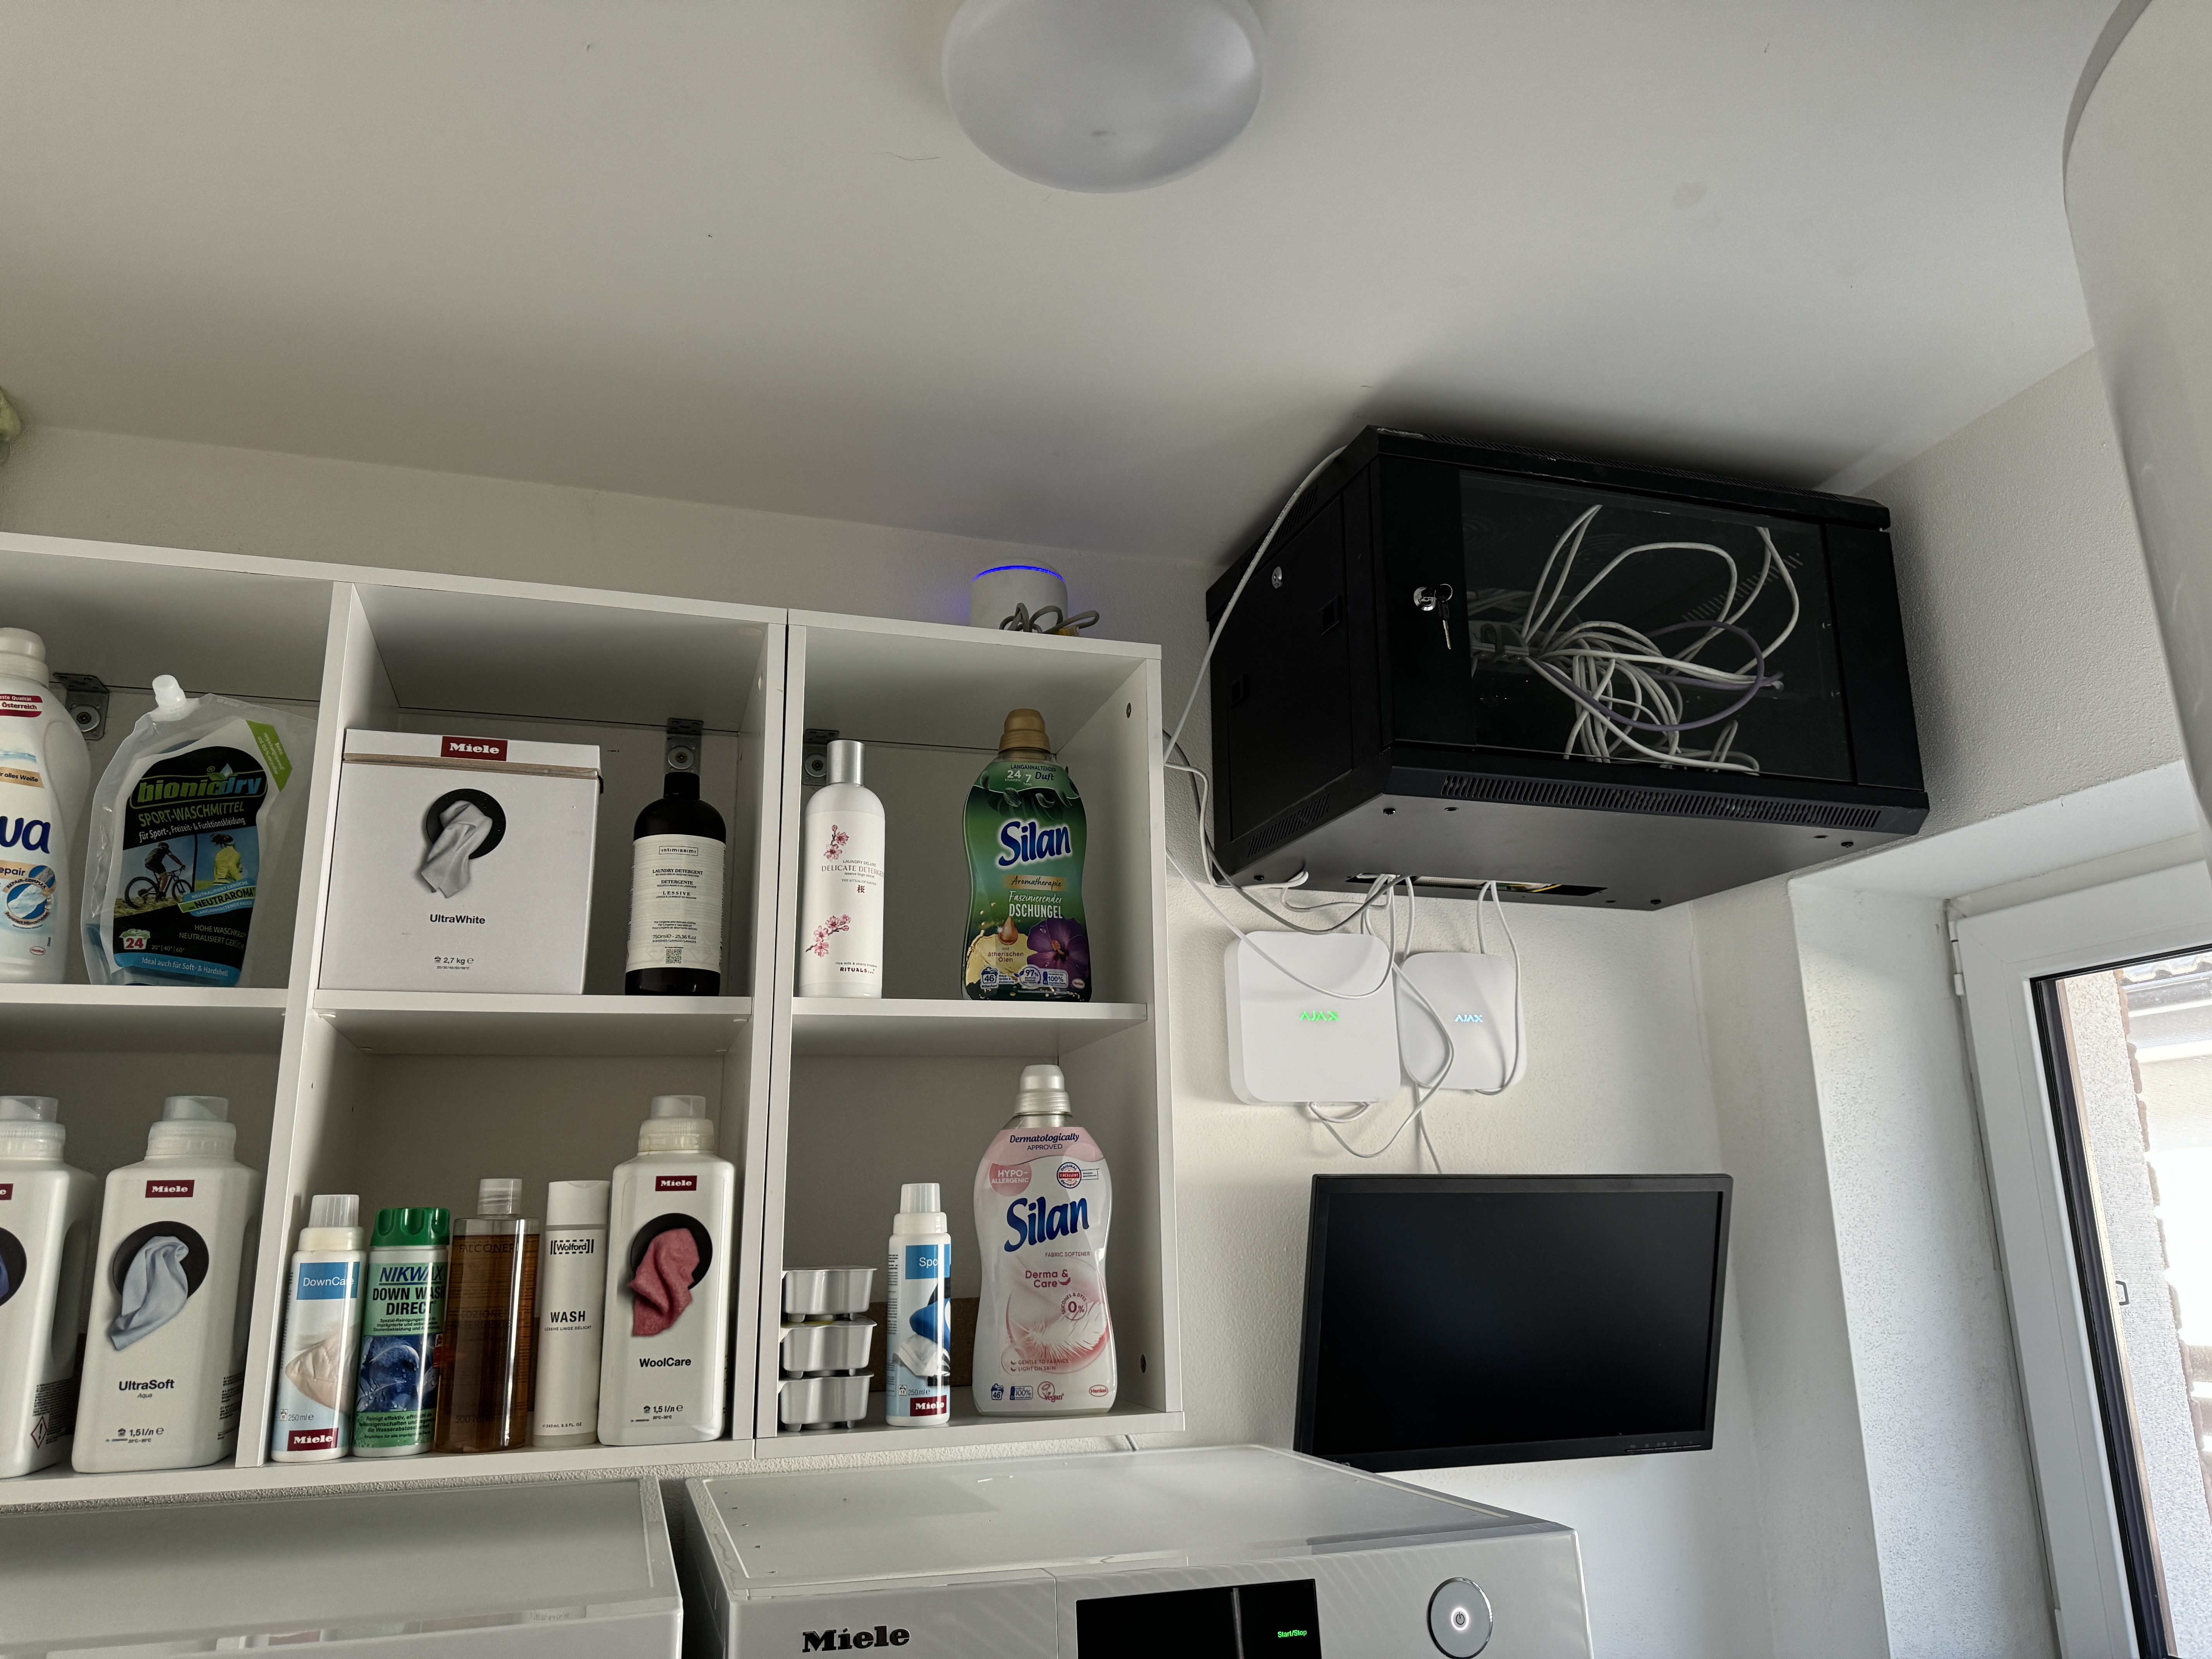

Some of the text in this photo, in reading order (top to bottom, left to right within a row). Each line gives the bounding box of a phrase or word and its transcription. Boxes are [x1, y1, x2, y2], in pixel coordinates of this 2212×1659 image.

[450, 743, 500, 754] Miele
[1035, 772, 1054, 781] Duft
[137, 777, 262, 802] bionicdry
[138, 801, 244, 827] SPORT-WASCHMITTEL
[139, 830, 149, 843] für
[171, 824, 192, 834] Freizeit-
[198, 817, 246, 830] Funktionskleidung
[998, 821, 1071, 866] Silan
[857, 884, 865, 893] 桜
[1011, 876, 1061, 890] Aromatherapie
[194, 887, 253, 908] NEUTRAROMA
[1009, 891, 1063, 904] Faszinierender
[1009, 903, 1063, 919] DSCHUNGEL
[430, 914, 486, 924] UltraWhite
[125, 938, 144, 948] 24
[179, 933, 225, 944] NEUTRALISIERT
[203, 967, 228, 977] Hardshell
[1300, 1011, 1340, 1021] AJAX
[1455, 1014, 1484, 1023] AJAX
[1010, 1133, 1079, 1143] Dermatologically
[1004, 1196, 1089, 1252] Silan
[556, 1243, 587, 1251] Wolford
[379, 1266, 443, 1282] NIKWAX
[1025, 1269, 1068, 1278] Derma &
[303, 1277, 354, 1286] DownCae
[1034, 1279, 1057, 1288] Care
[373, 1288, 410, 1301] DOWN
[386, 1301, 434, 1316] DIRECT
[1061, 1293, 1072, 1315] SILICONES
[1077, 1293, 1087, 1302] DYES
[550, 1310, 586, 1322] WASH
[639, 1357, 691, 1367] WoolCare
[119, 1379, 174, 1391] UltraSoft
[915, 1401, 945, 1410] Miele
[129, 1429, 141, 1437] 1,5
[294, 1435, 333, 1444] Miele
[802, 1625, 910, 1652] Miele
[1278, 1630, 1307, 1638] Start/Stop
